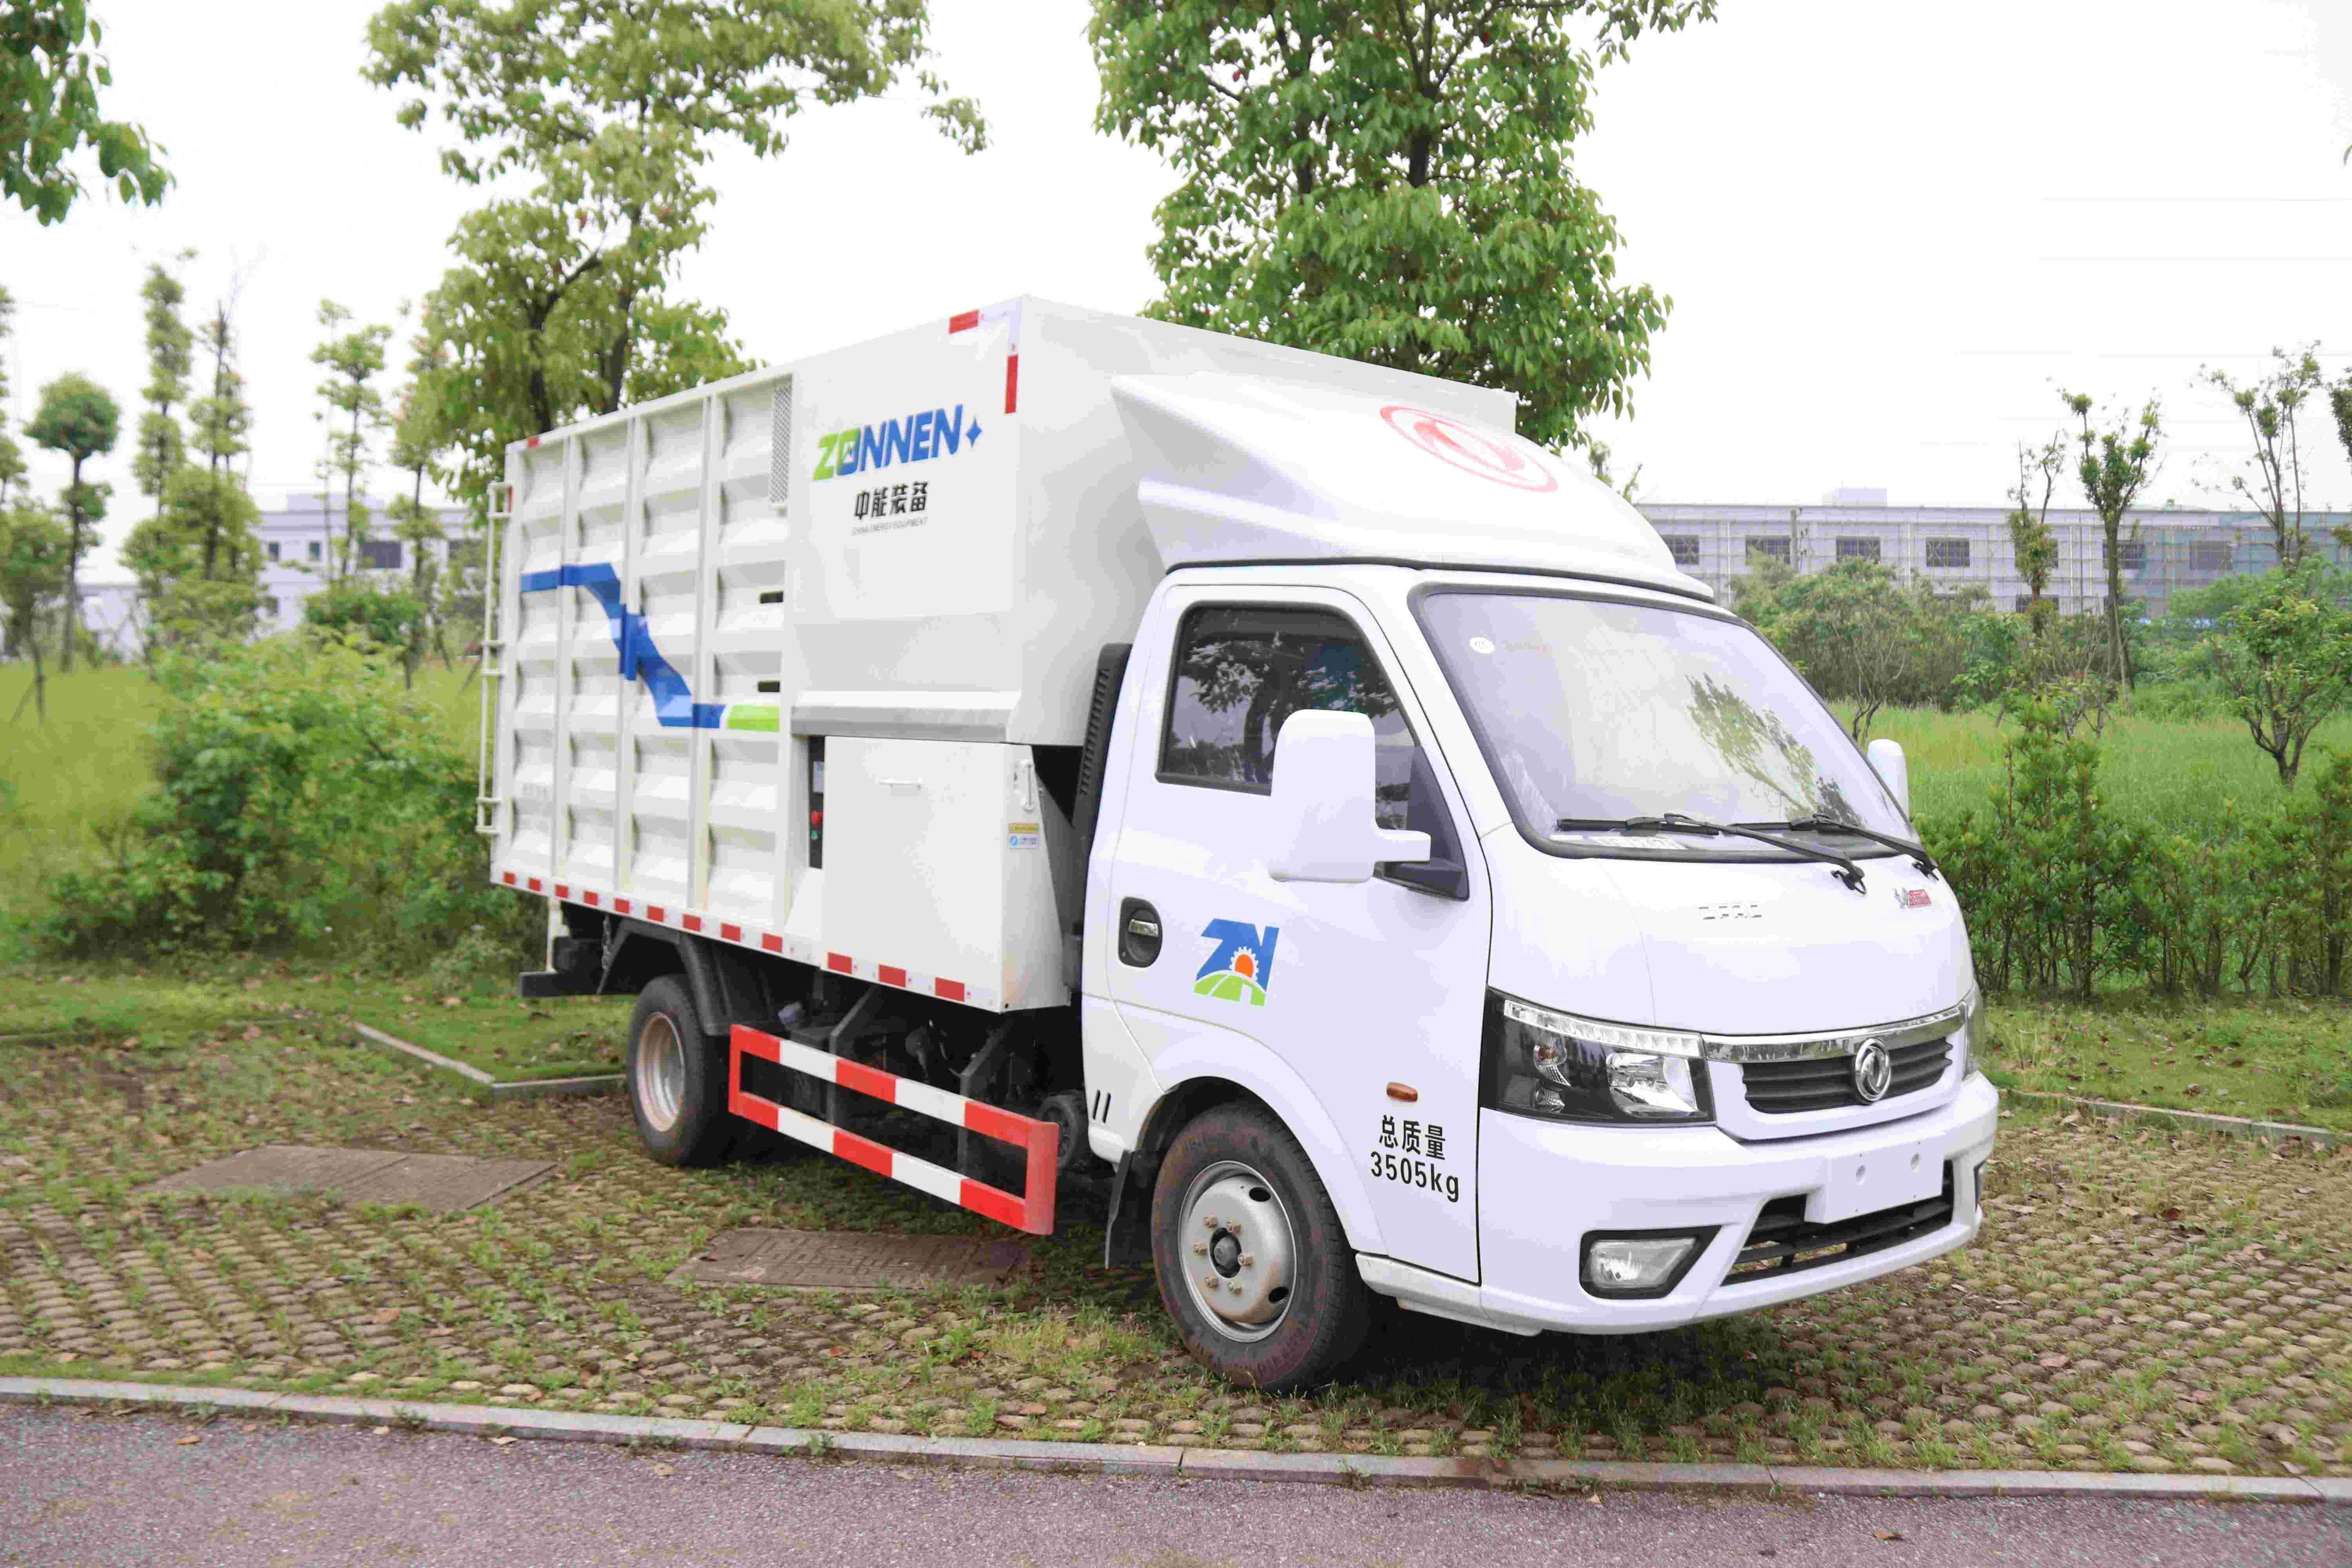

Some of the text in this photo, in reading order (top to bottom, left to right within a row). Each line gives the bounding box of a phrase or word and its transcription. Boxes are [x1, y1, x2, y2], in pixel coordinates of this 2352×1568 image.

[813, 404, 963, 481] ZONNEN
[854, 481, 929, 519] 中能装备
[1379, 1114, 1446, 1160] 总质量
[1370, 1151, 1459, 1203] 3505kg
